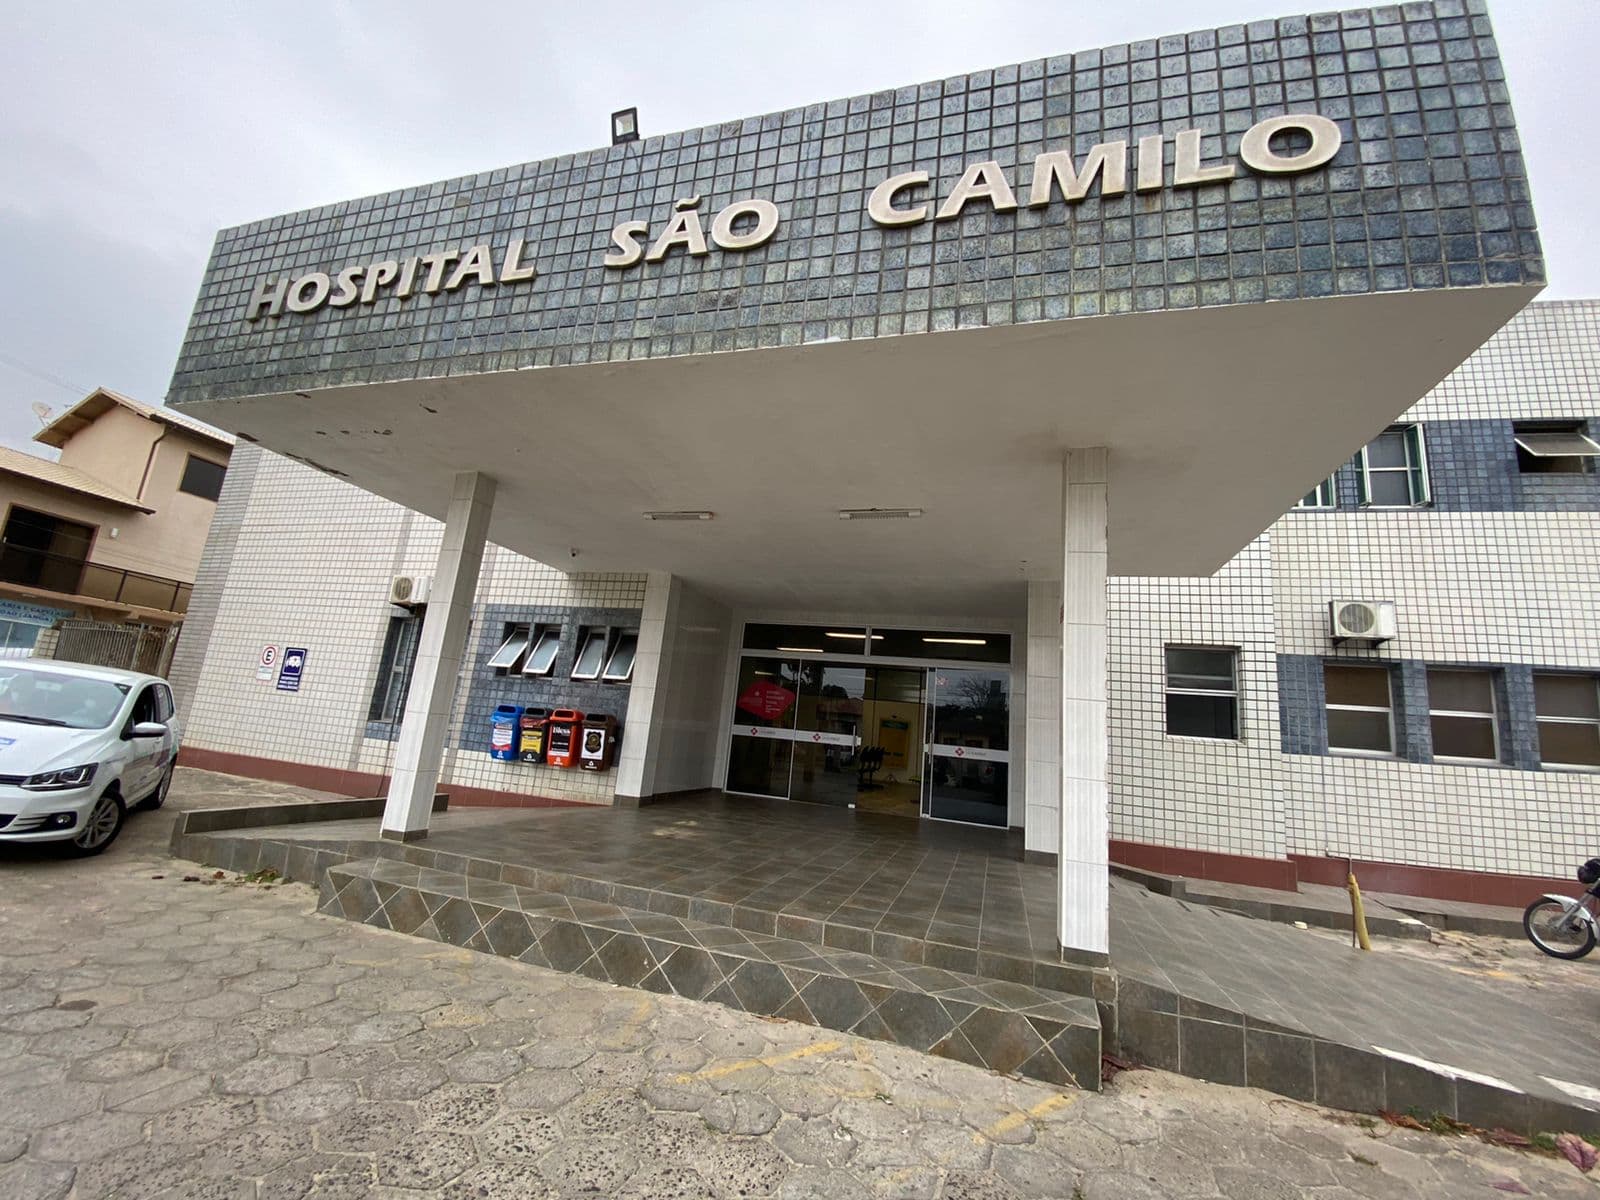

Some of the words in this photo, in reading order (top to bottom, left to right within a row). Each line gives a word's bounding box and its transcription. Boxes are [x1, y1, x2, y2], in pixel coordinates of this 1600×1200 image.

[245, 238, 537, 322] HOSPITAL
[603, 194, 779, 269] SÃO
[867, 113, 1342, 228] CAMILO
[265, 650, 273, 662] E
